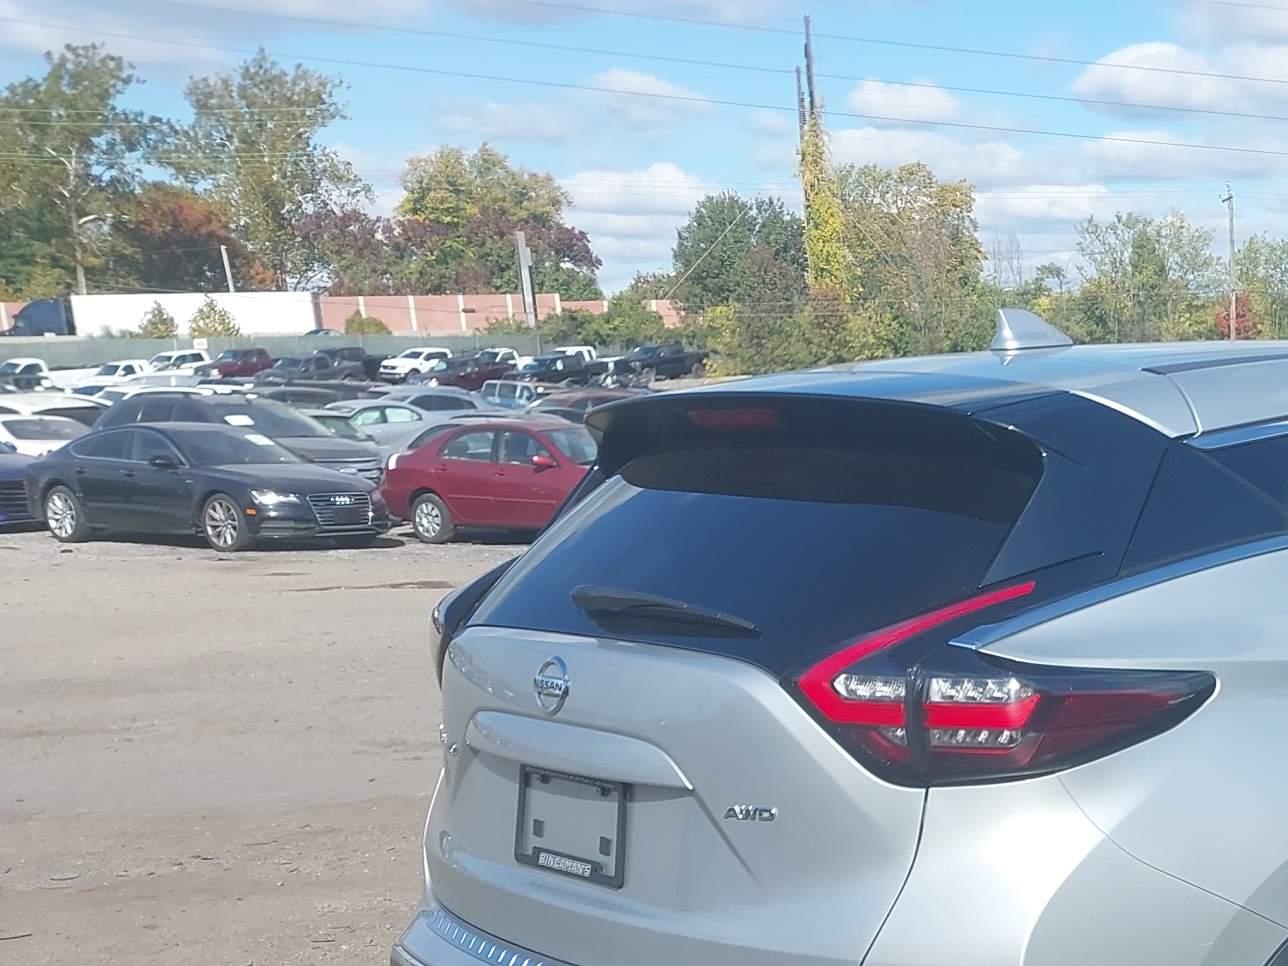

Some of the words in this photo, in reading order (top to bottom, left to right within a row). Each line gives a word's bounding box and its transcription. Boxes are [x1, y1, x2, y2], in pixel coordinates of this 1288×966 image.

[533, 677, 563, 692] NISSAN
[723, 804, 779, 823] AWD
[538, 851, 592, 878] BINGAMAN'S
